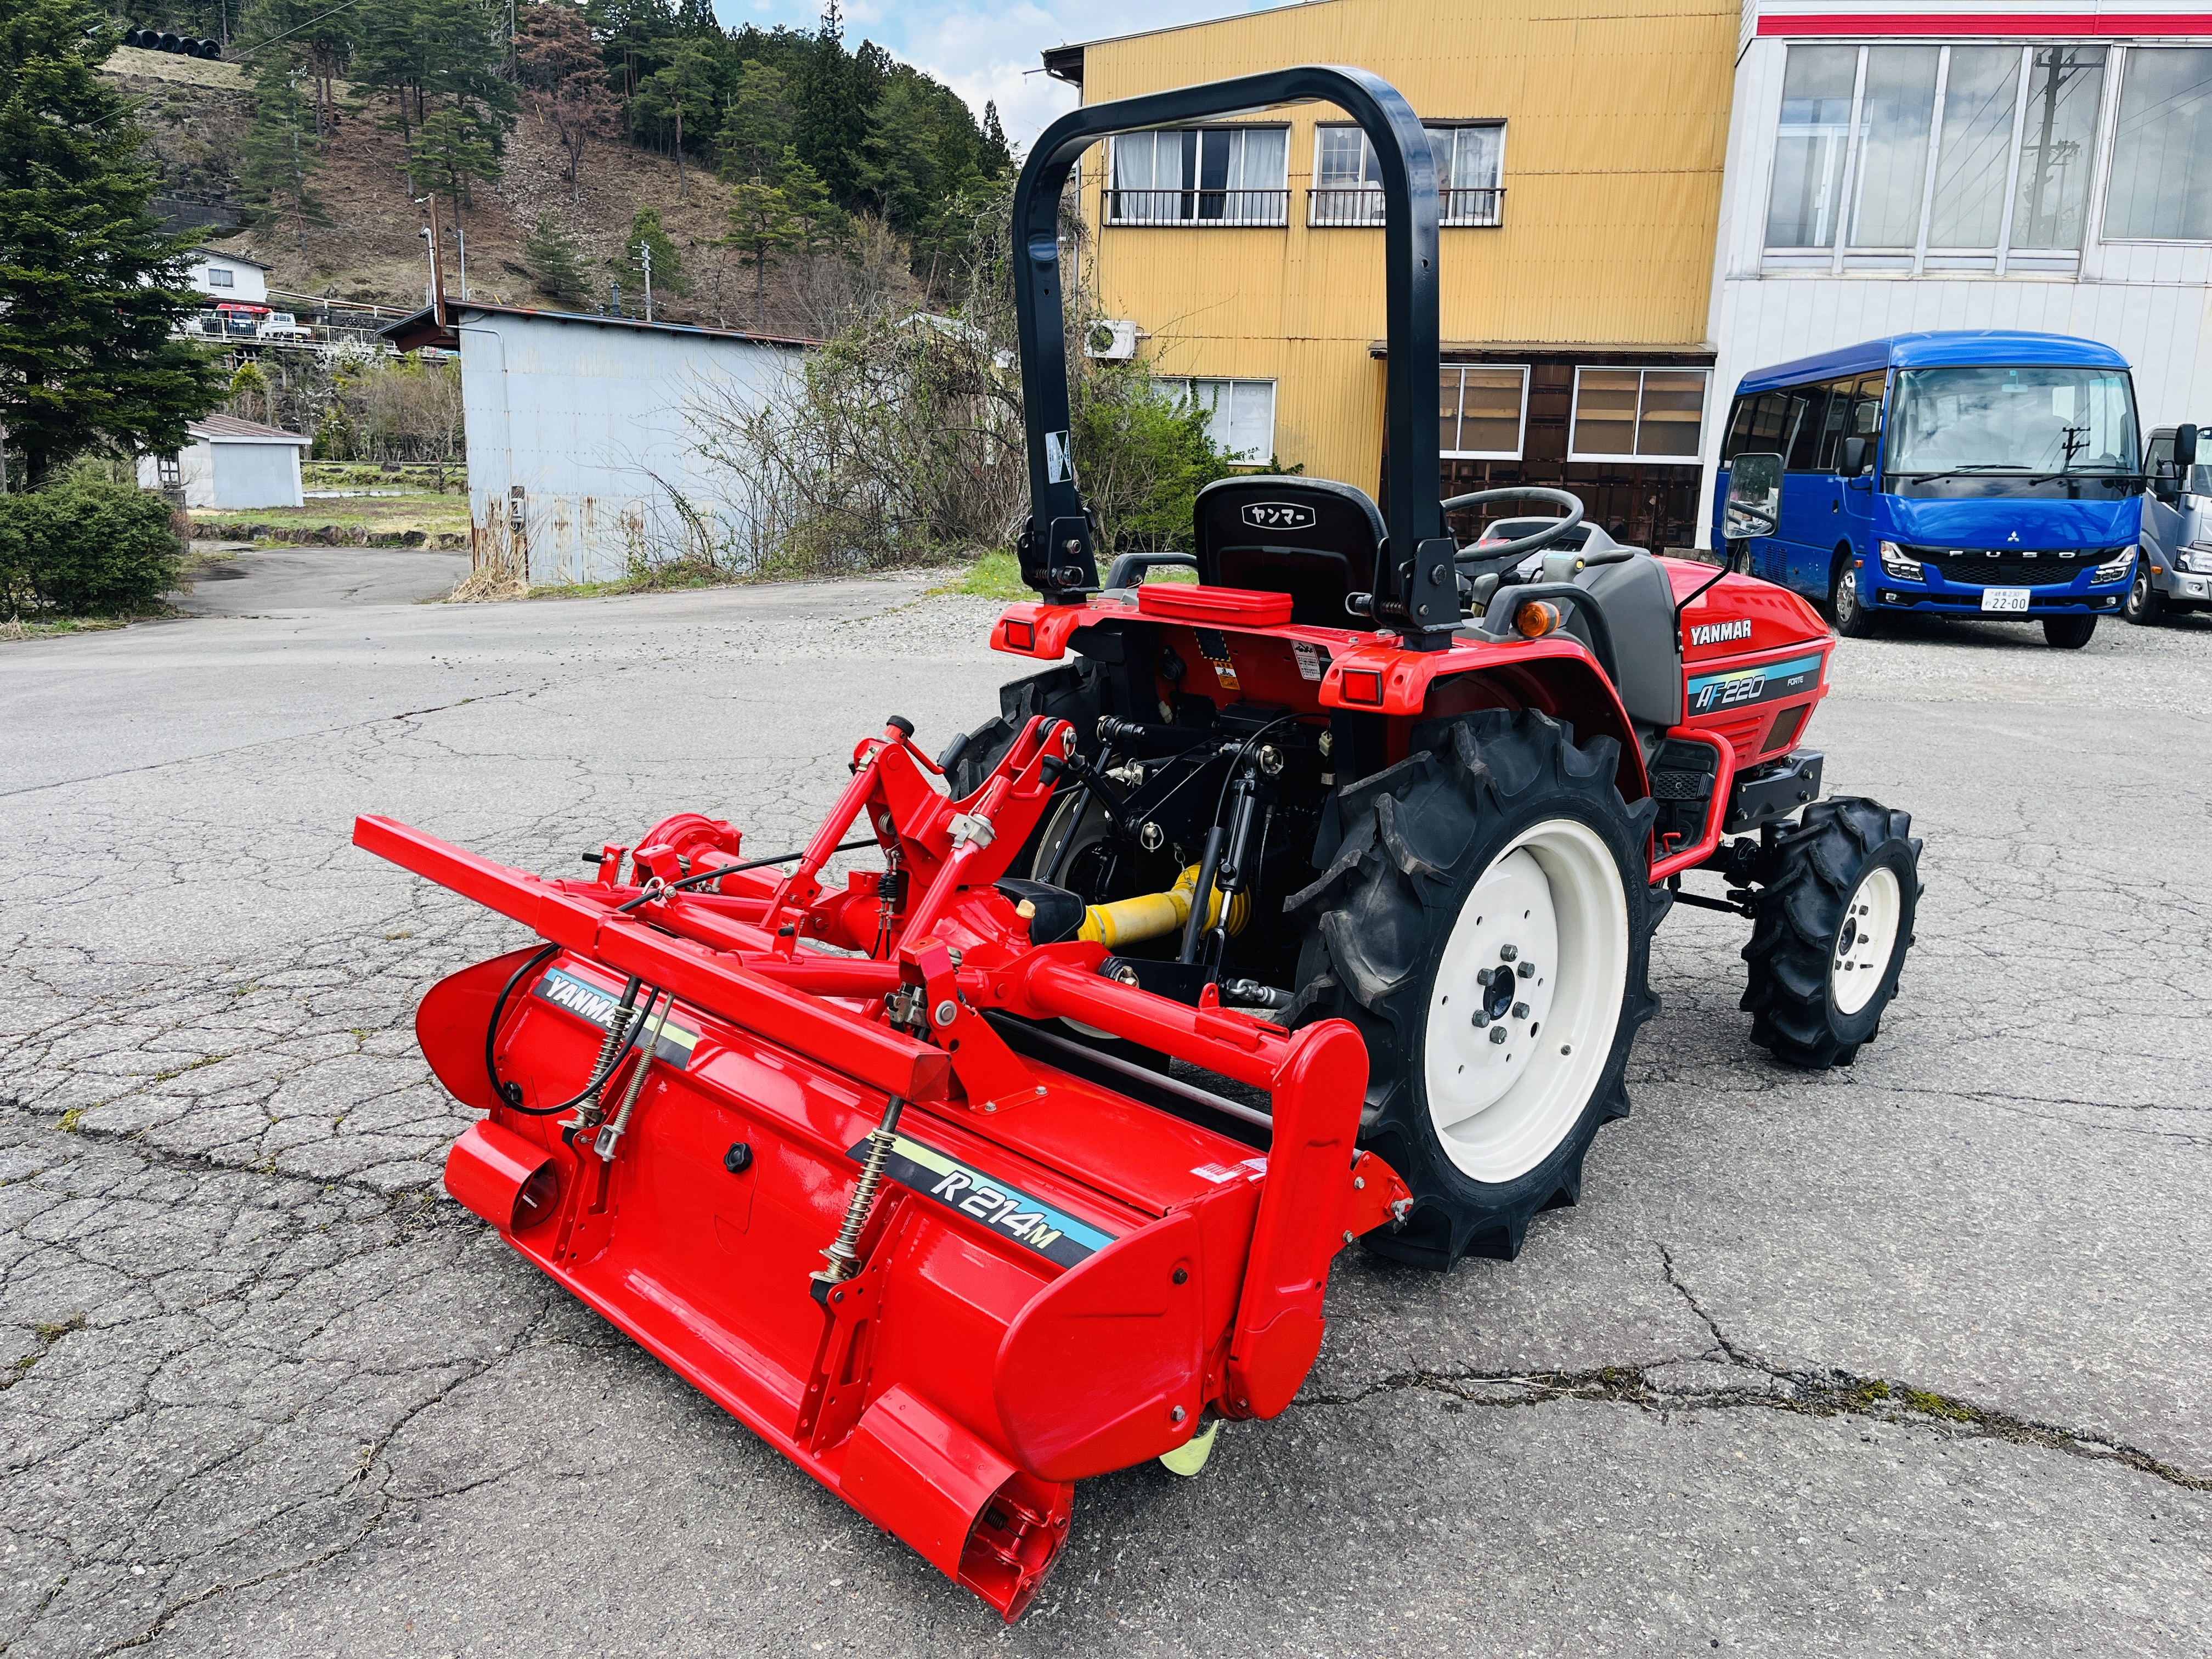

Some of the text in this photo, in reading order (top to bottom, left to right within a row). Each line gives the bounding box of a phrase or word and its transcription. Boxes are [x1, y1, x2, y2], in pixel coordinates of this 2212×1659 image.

[1252, 506, 1305, 524] ヤンマー
[1993, 598, 2026, 609] 22-00
[1690, 619, 1751, 646] YANMAR
[1696, 675, 1804, 713] AF220 FORTE
